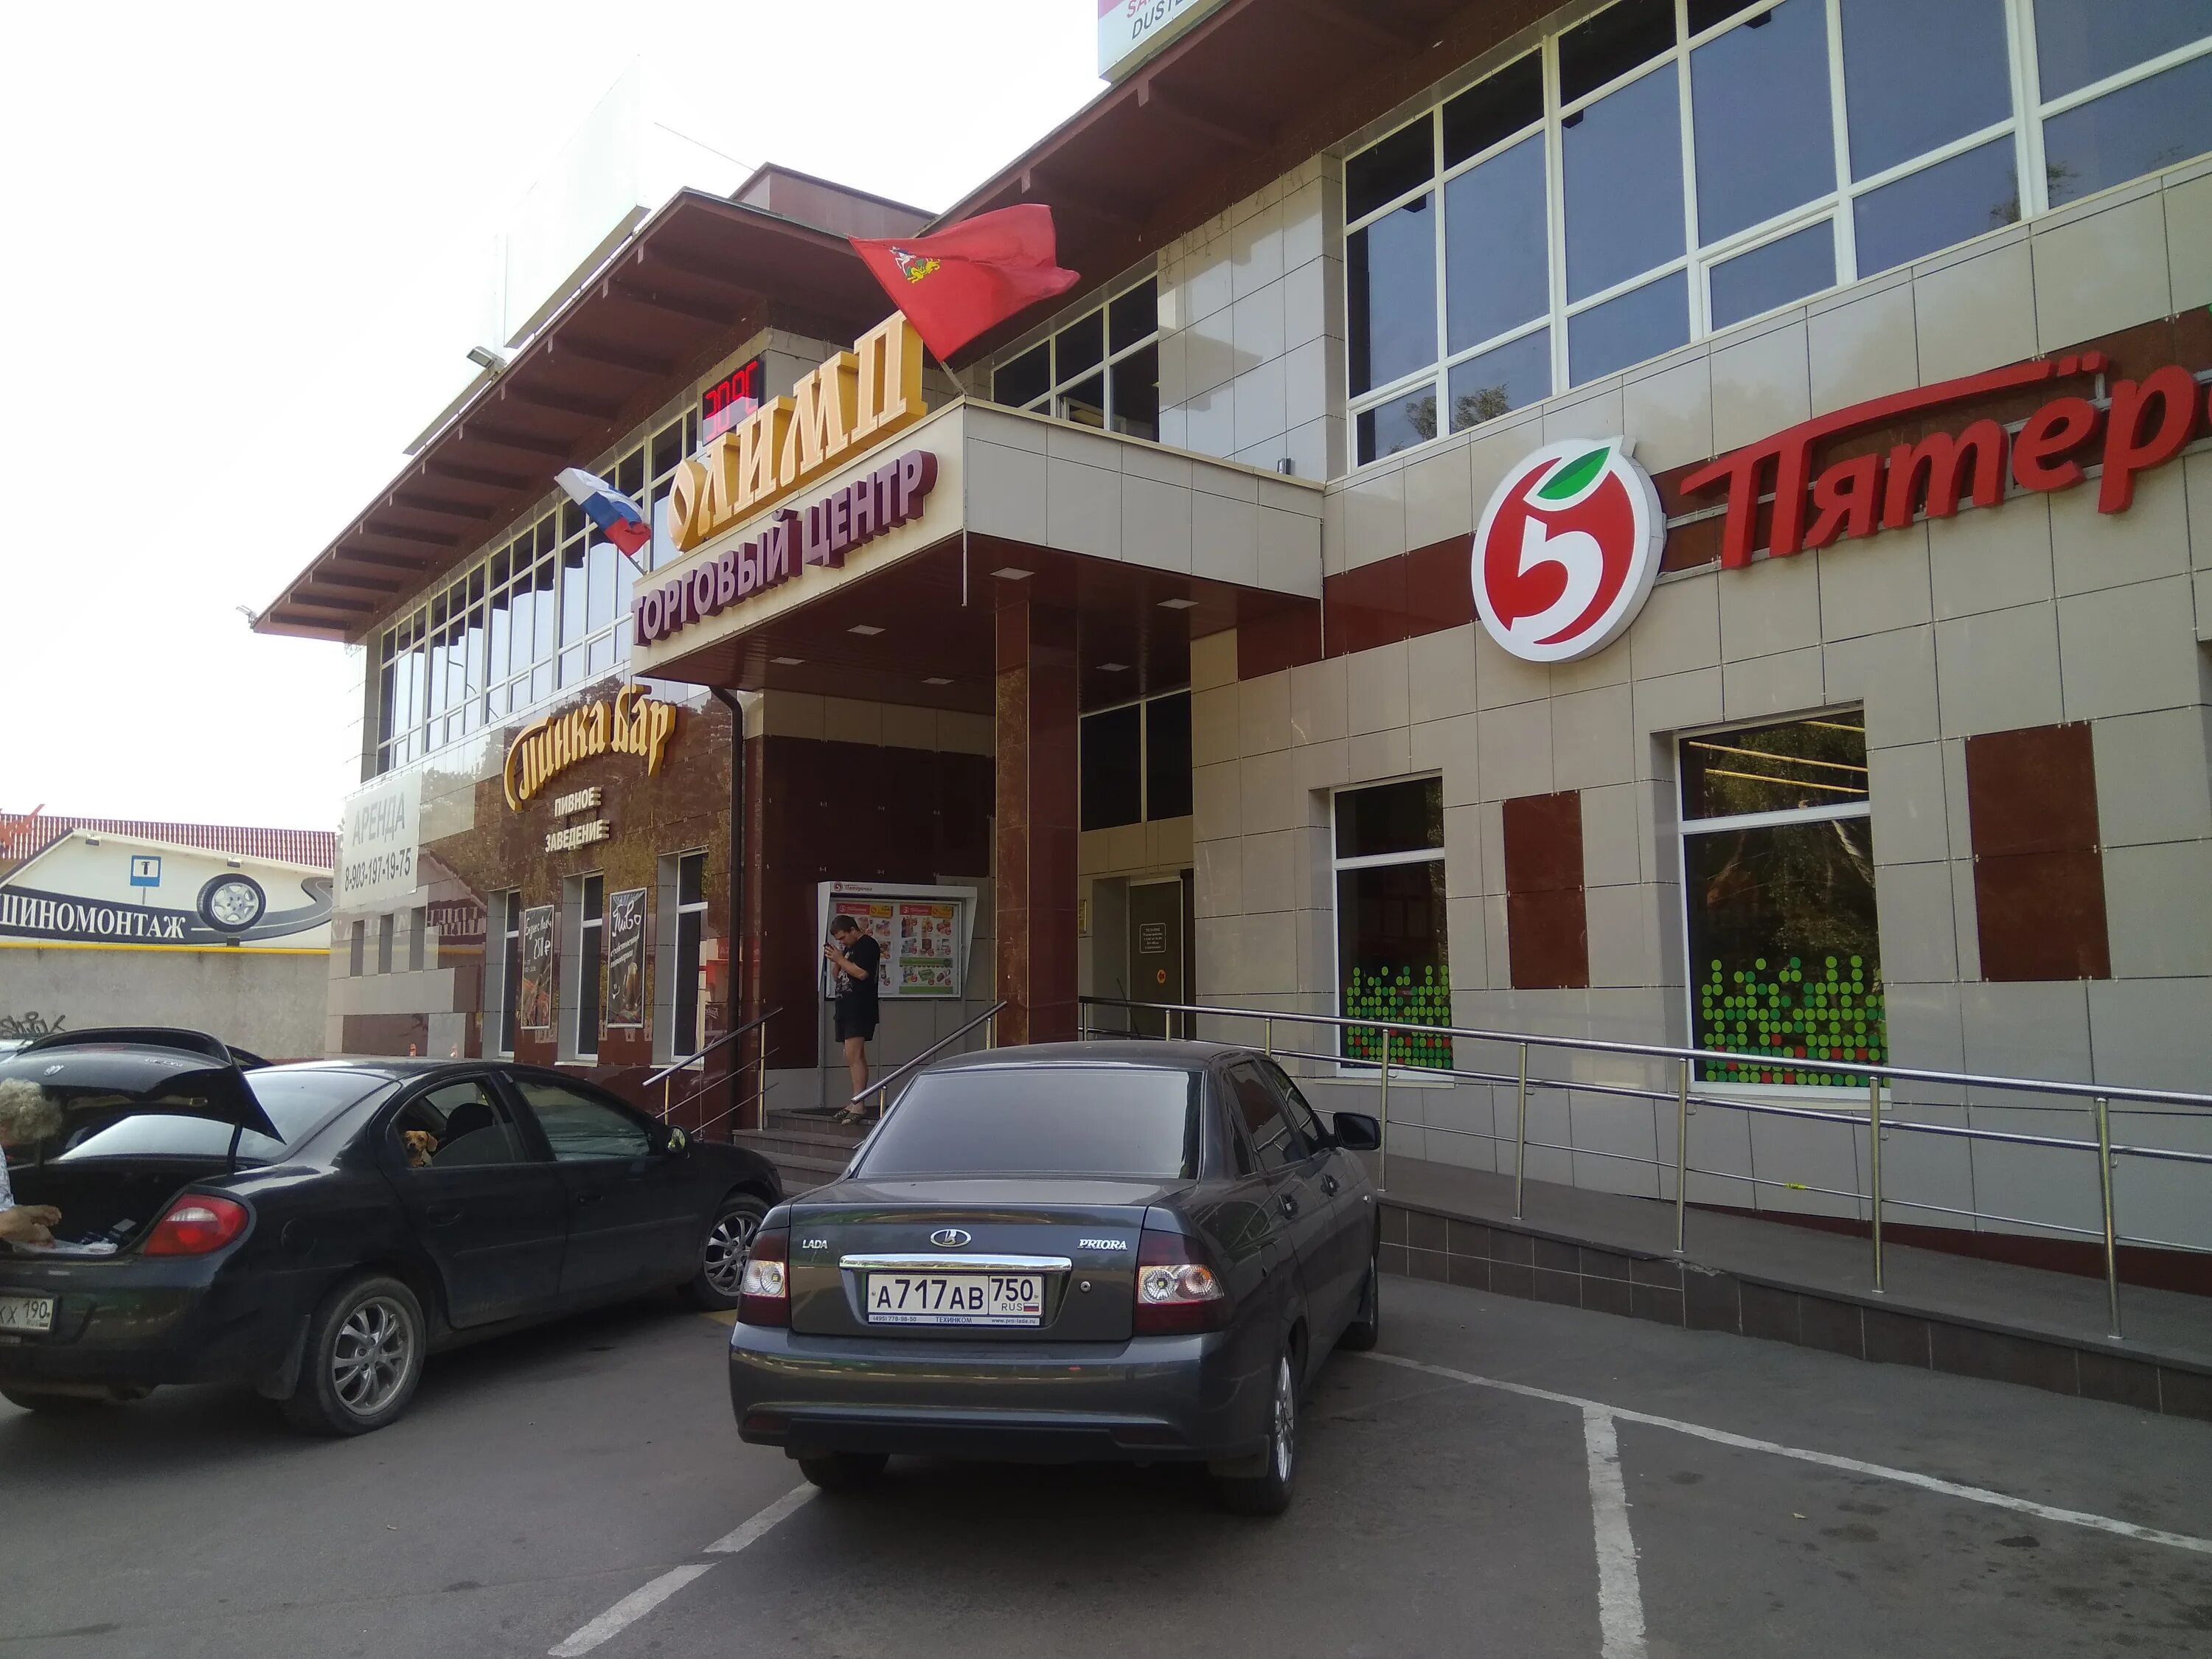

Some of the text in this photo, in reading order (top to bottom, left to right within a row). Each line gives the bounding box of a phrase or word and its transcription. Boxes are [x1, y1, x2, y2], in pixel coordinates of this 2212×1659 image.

[668, 309, 928, 552] ОЛИМП
[1680, 349, 2212, 571] Пятёр
[630, 448, 939, 647] ТОРГОВЫЙ ЦЕНТР
[352, 792, 405, 846] АРЕНДА
[554, 786, 602, 817] ПИВНОЕ
[545, 818, 610, 853] ЗАВЕДЕНИЕ
[344, 847, 411, 891] 8-903-197-19-75
[0, 893, 186, 939] ШИНОМОНТАЖ
[802, 1239, 828, 1249] LADA
[1077, 1239, 1128, 1251] PRIORA
[876, 1278, 1033, 1310] А717АВ 750
[1001, 1302, 1023, 1312] RUS
[936, 1316, 973, 1324] ТЕХИНКОМ
